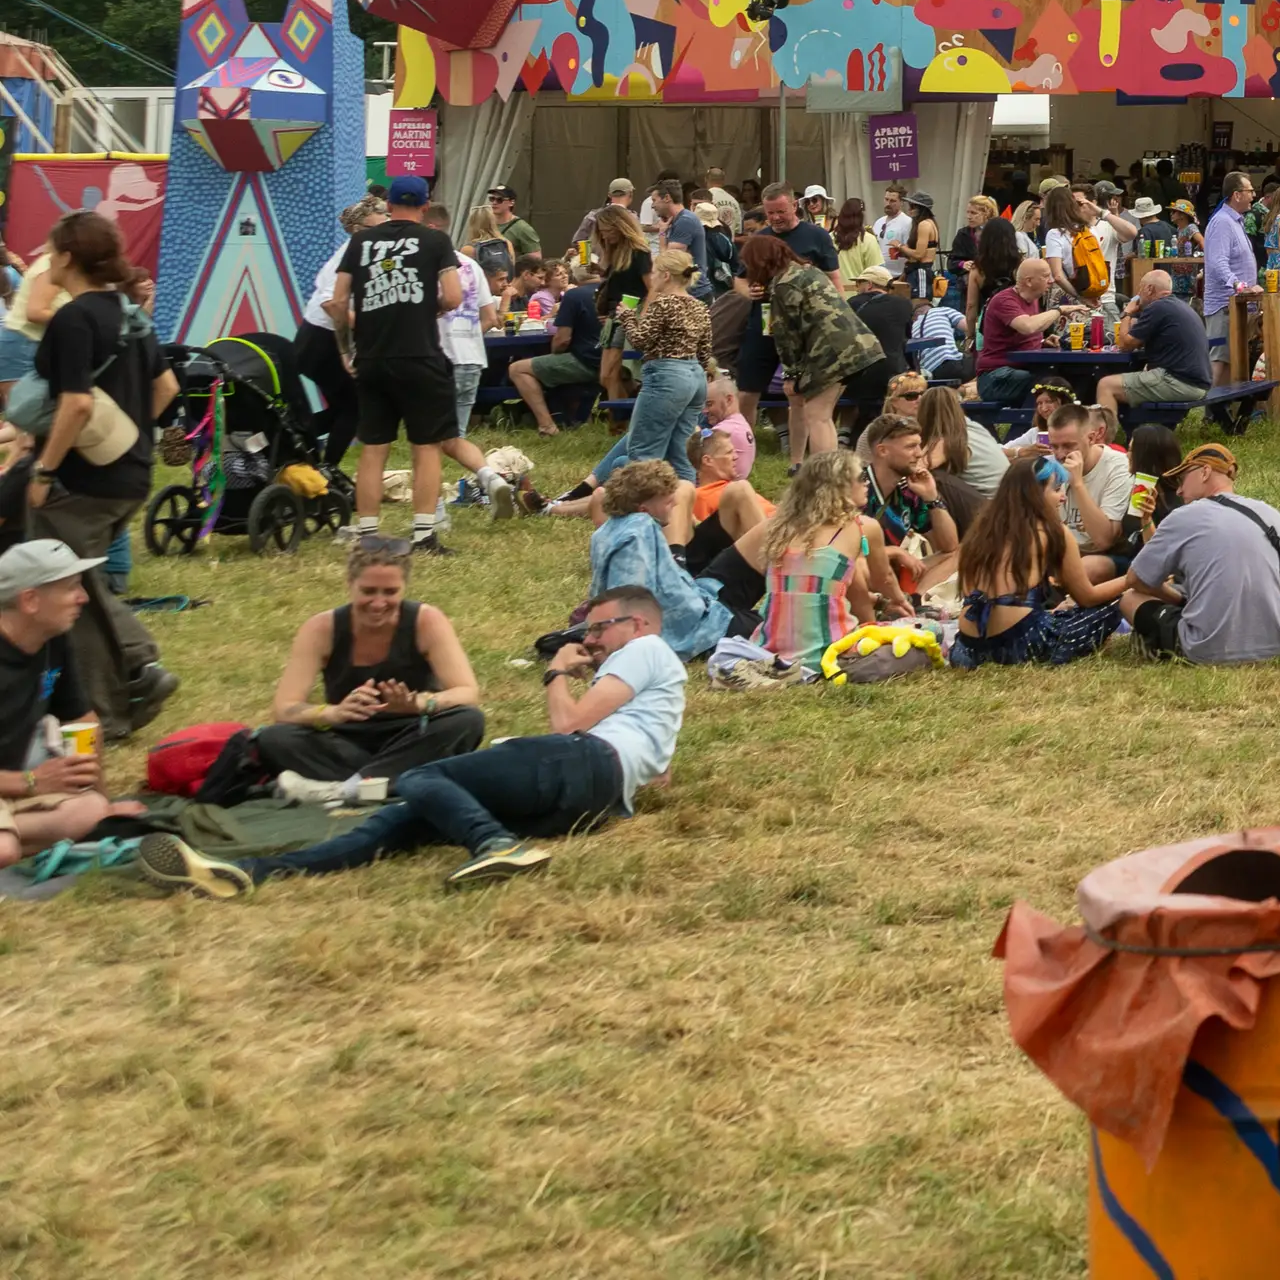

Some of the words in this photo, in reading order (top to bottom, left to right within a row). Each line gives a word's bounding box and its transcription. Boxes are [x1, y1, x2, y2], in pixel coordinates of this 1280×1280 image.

[392, 130, 432, 139] MARTINI
[874, 126, 913, 136] APEROL
[392, 140, 432, 149] COCKTAIL
[874, 136, 913, 150] SPRITZ
[360, 237, 420, 267] IT'S
[363, 267, 419, 298] THAT
[361, 281, 424, 312] SERIOUS
